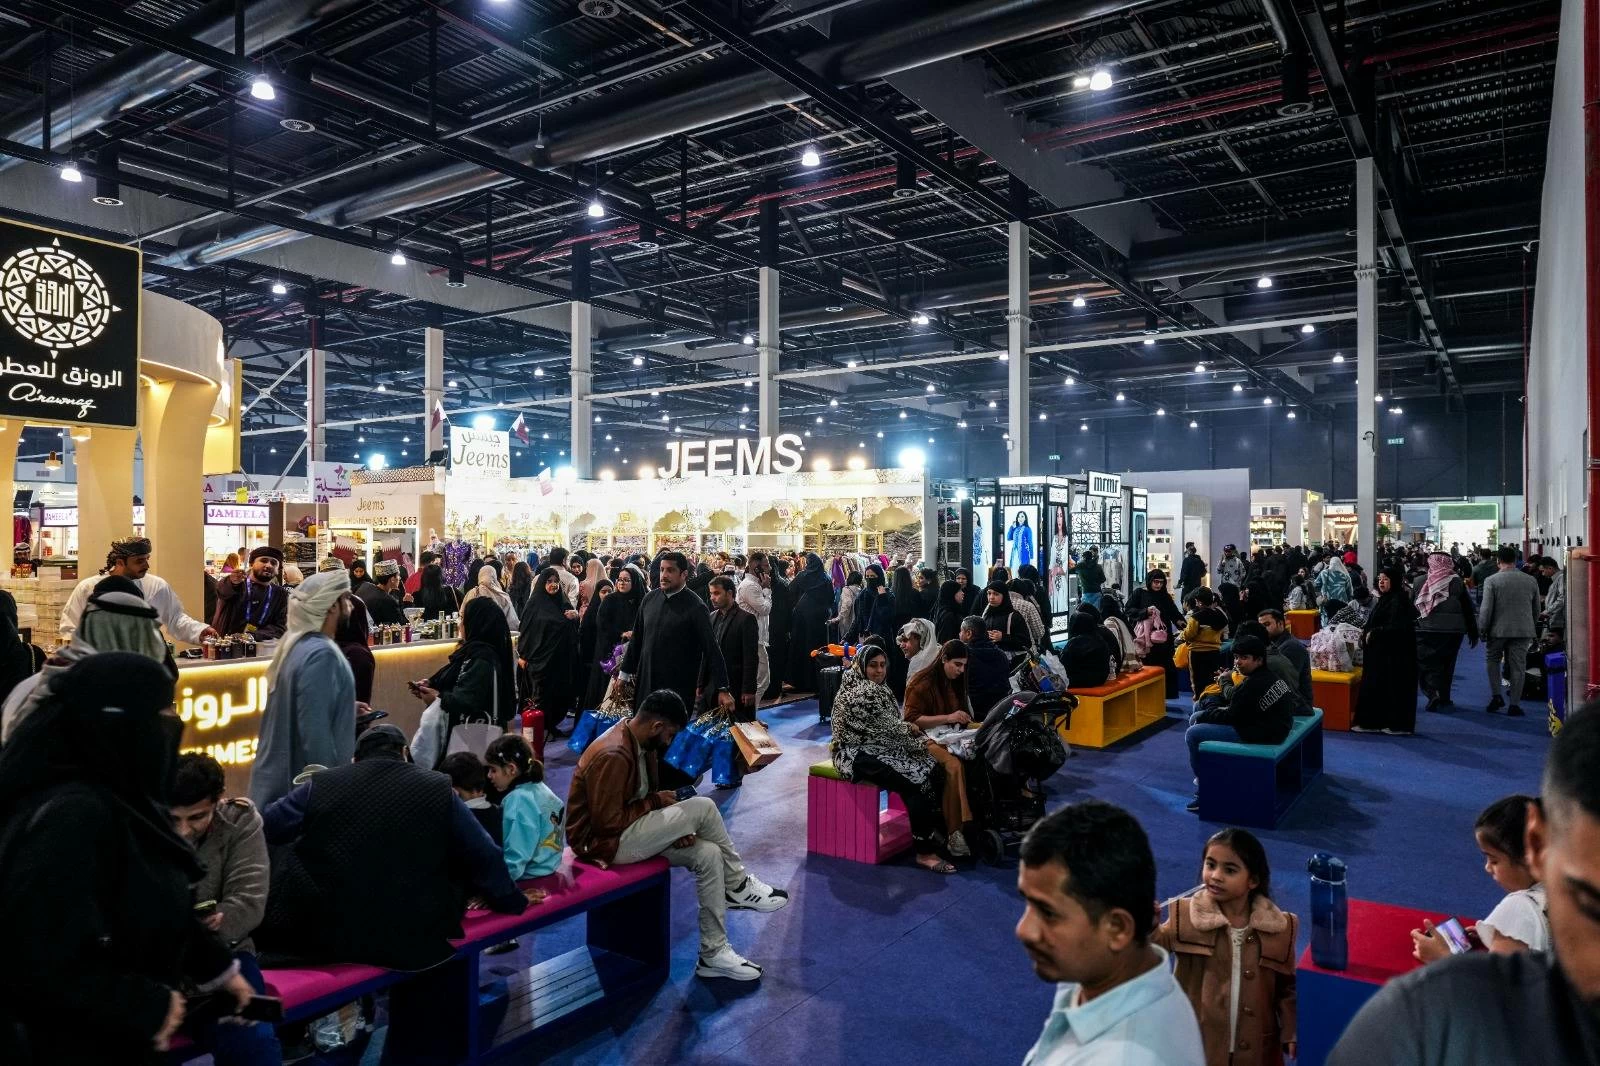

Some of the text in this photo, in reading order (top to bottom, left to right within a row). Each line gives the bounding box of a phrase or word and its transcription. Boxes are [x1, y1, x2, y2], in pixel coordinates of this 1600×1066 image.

[0, 356, 122, 389] الرونق للعط
[452, 444, 509, 469] Jeems
[657, 433, 803, 479] JEEMS
[208, 508, 267, 519] JAMEELA
[357, 498, 385, 511] Jeems
[176, 676, 268, 730] الرون
